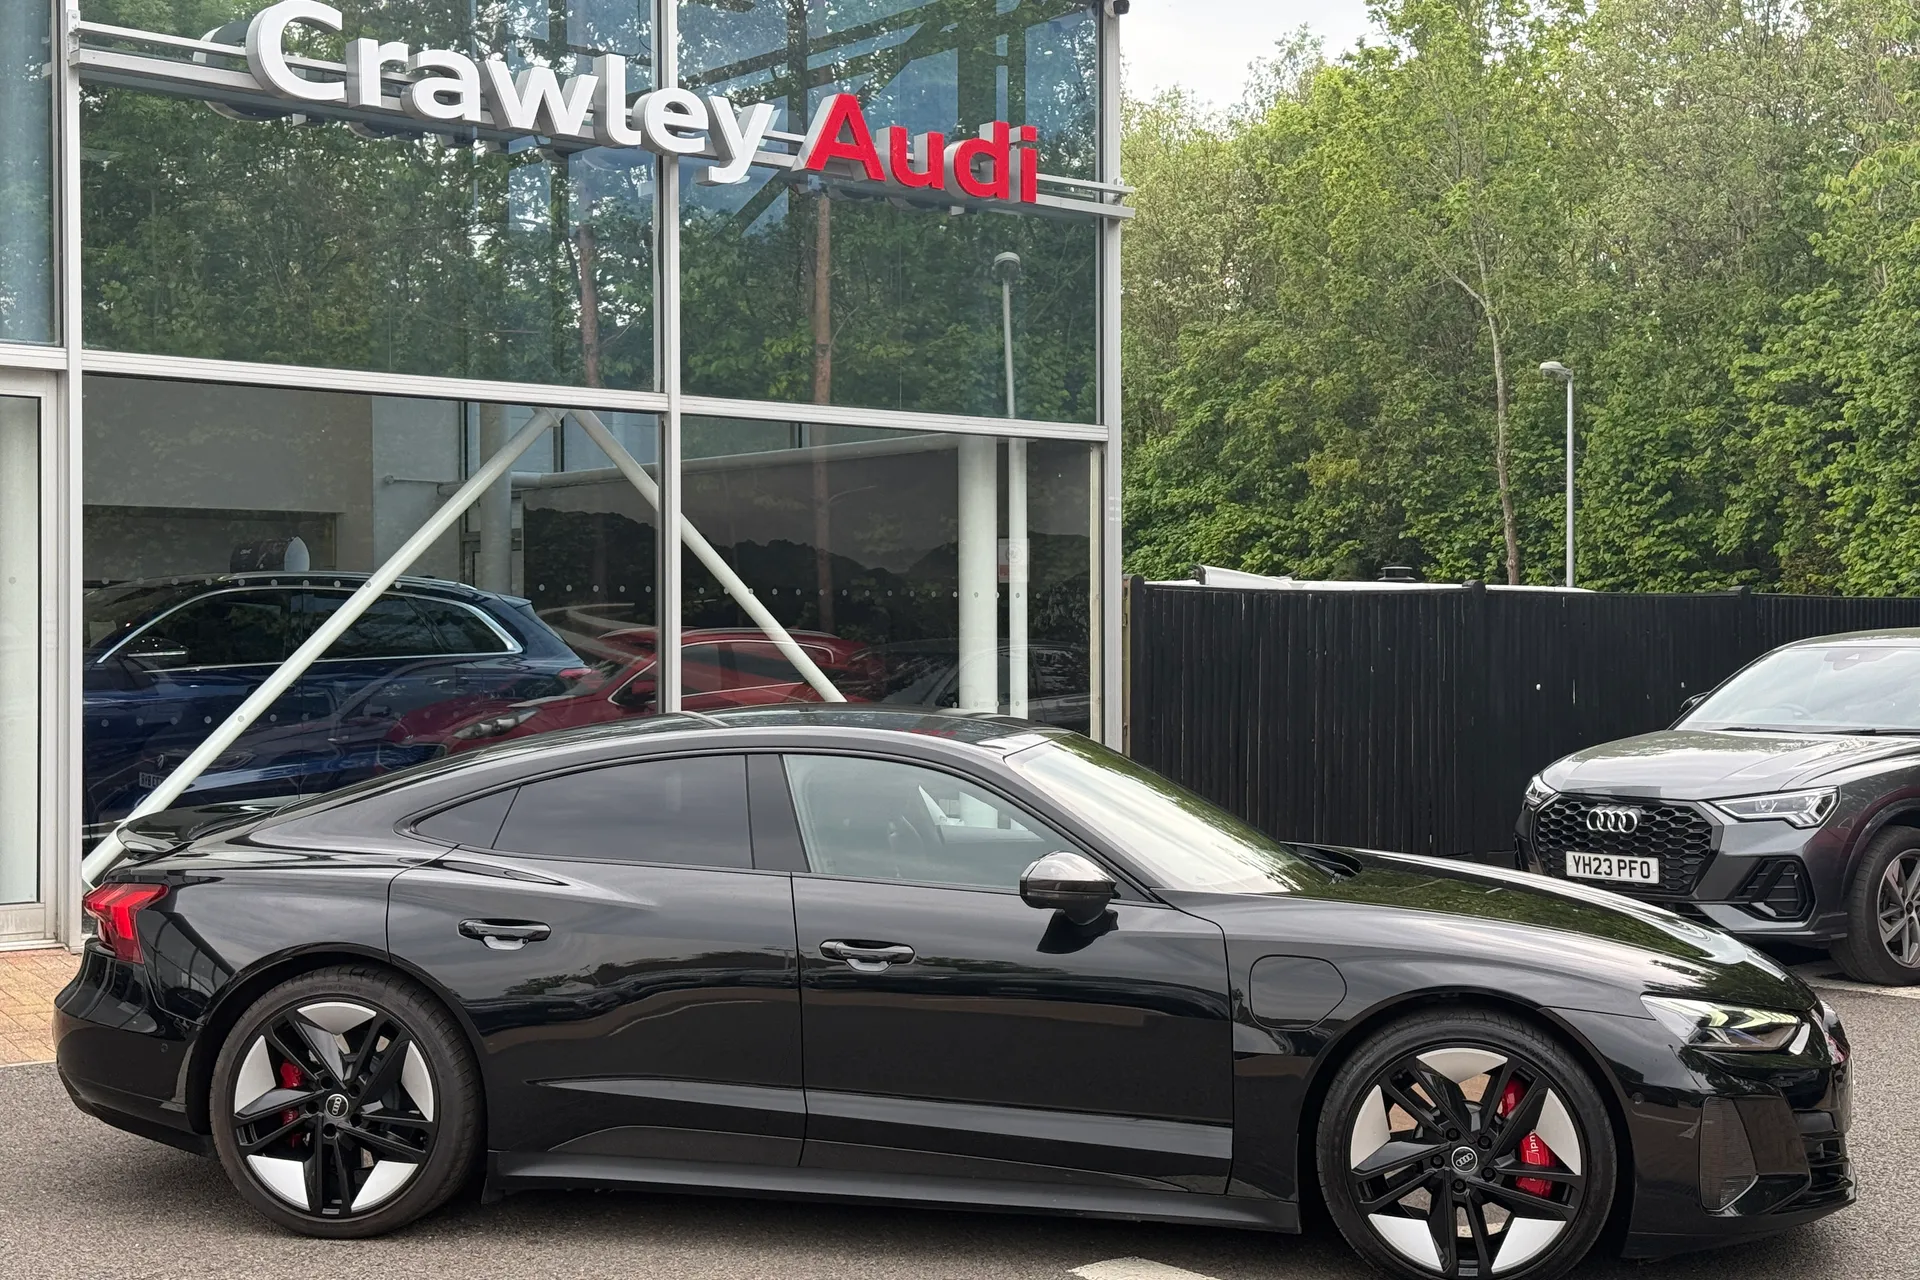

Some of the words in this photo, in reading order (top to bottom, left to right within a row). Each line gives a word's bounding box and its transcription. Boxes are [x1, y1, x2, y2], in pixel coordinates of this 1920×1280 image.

[247, 0, 773, 185] Crawley
[806, 94, 1038, 204] Audi
[1572, 855, 1613, 876] YH23
[1617, 858, 1651, 879] PFO
